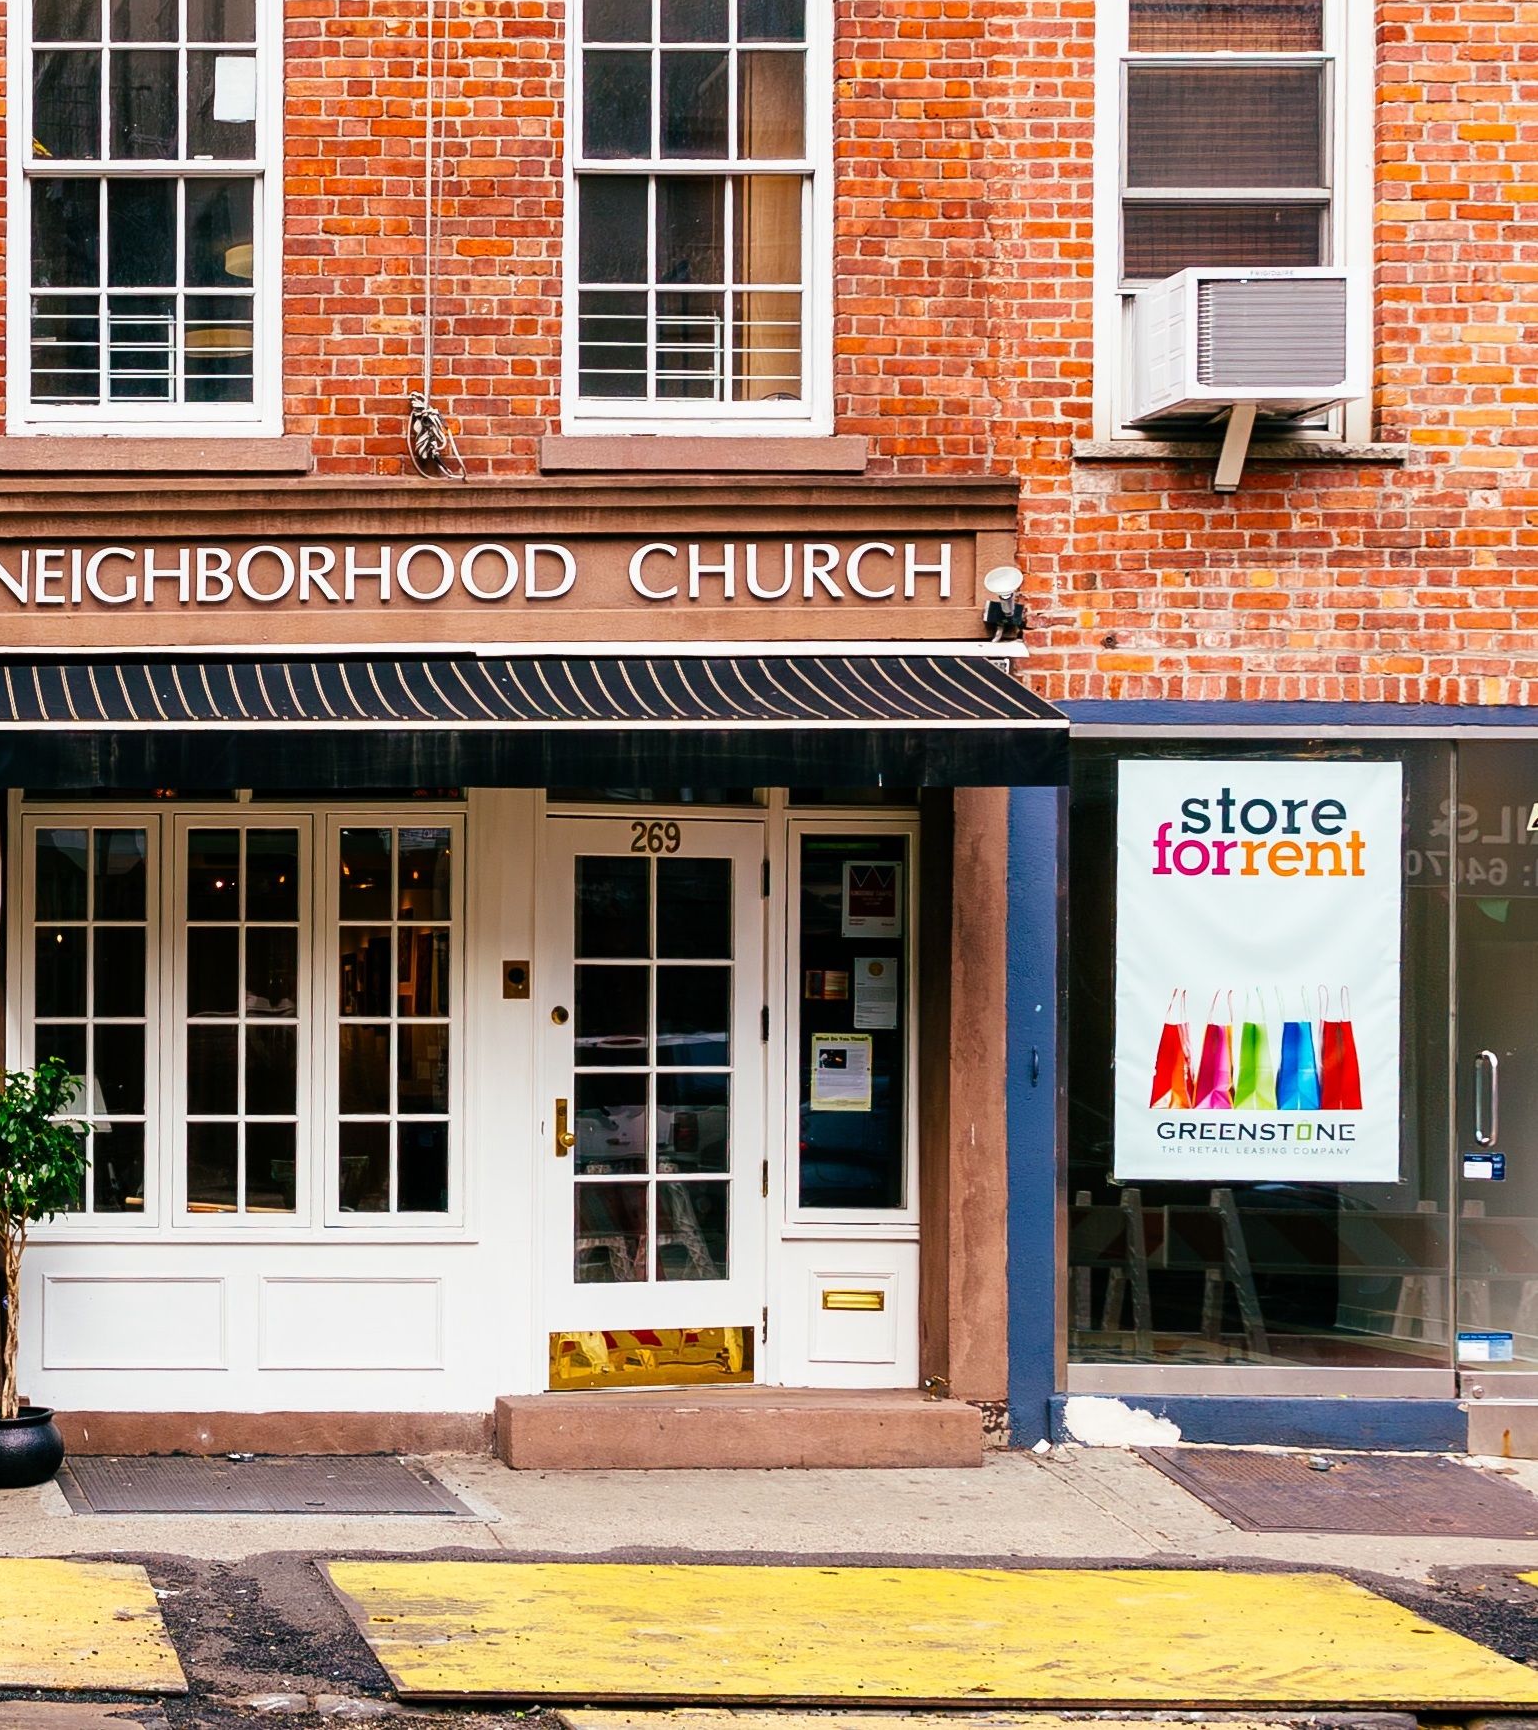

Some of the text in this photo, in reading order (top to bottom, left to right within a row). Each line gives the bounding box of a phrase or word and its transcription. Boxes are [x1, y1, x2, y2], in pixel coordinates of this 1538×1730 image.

[628, 541, 952, 601] CHURCH
[1181, 787, 1348, 836] store
[630, 821, 681, 854] 269
[1156, 1120, 1356, 1142] GREENSTONE
[1161, 1146, 1351, 1156] THE RETAIL LEASING COMPANY
